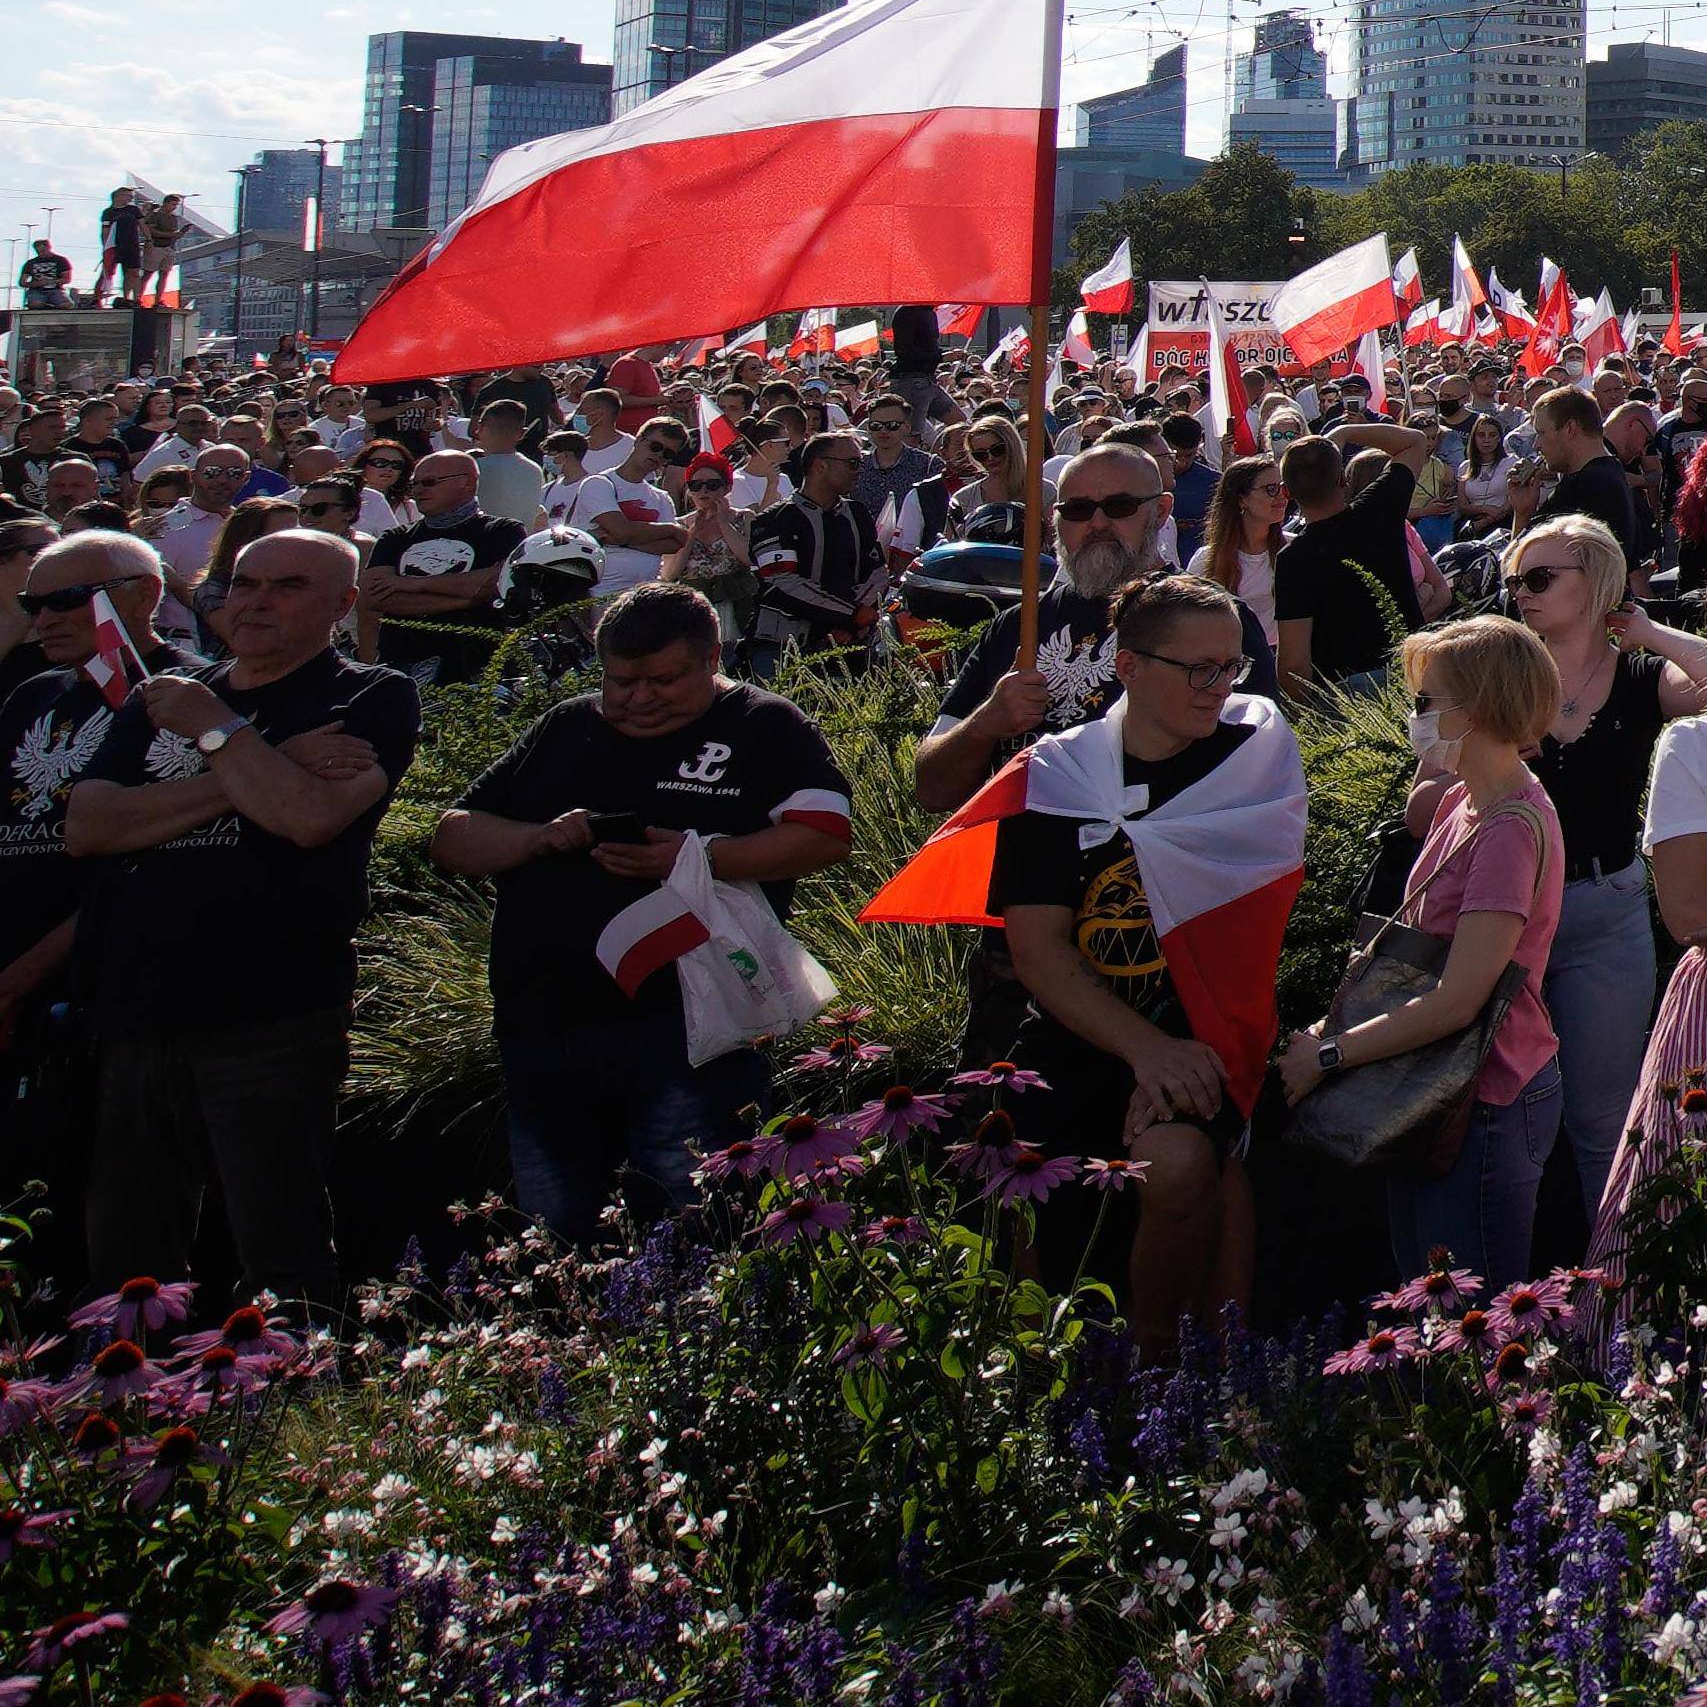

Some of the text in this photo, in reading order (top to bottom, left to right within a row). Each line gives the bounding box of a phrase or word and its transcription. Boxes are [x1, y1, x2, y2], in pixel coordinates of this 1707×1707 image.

[1154, 347, 1190, 366] BÓG
[1193, 348, 1260, 365] HOR
[656, 781, 713, 795] WARSZAWA
